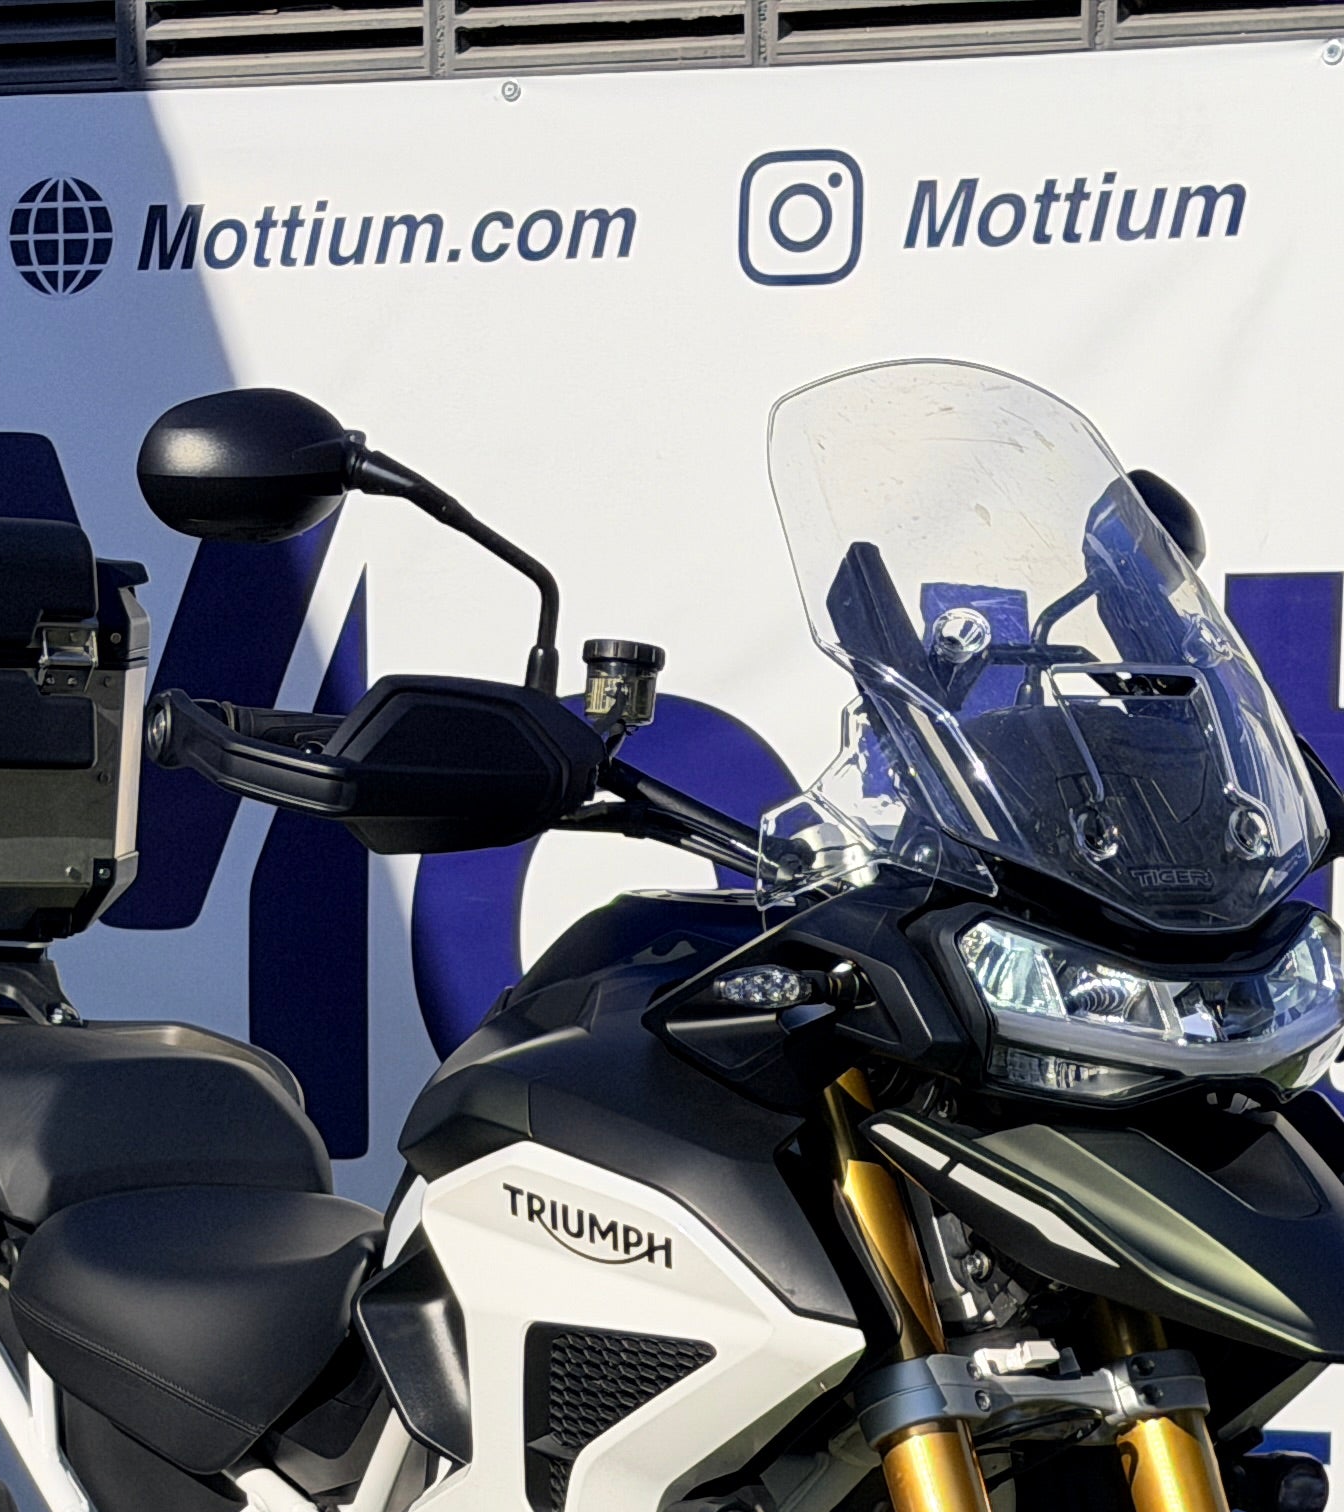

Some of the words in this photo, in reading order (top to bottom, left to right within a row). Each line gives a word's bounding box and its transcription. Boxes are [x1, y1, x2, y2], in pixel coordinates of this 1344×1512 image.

[137, 200, 637, 270] Mottium.com
[903, 171, 1247, 250] Mottium
[1130, 868, 1216, 889] TIGER
[502, 1182, 673, 1269] TRIUMPH
